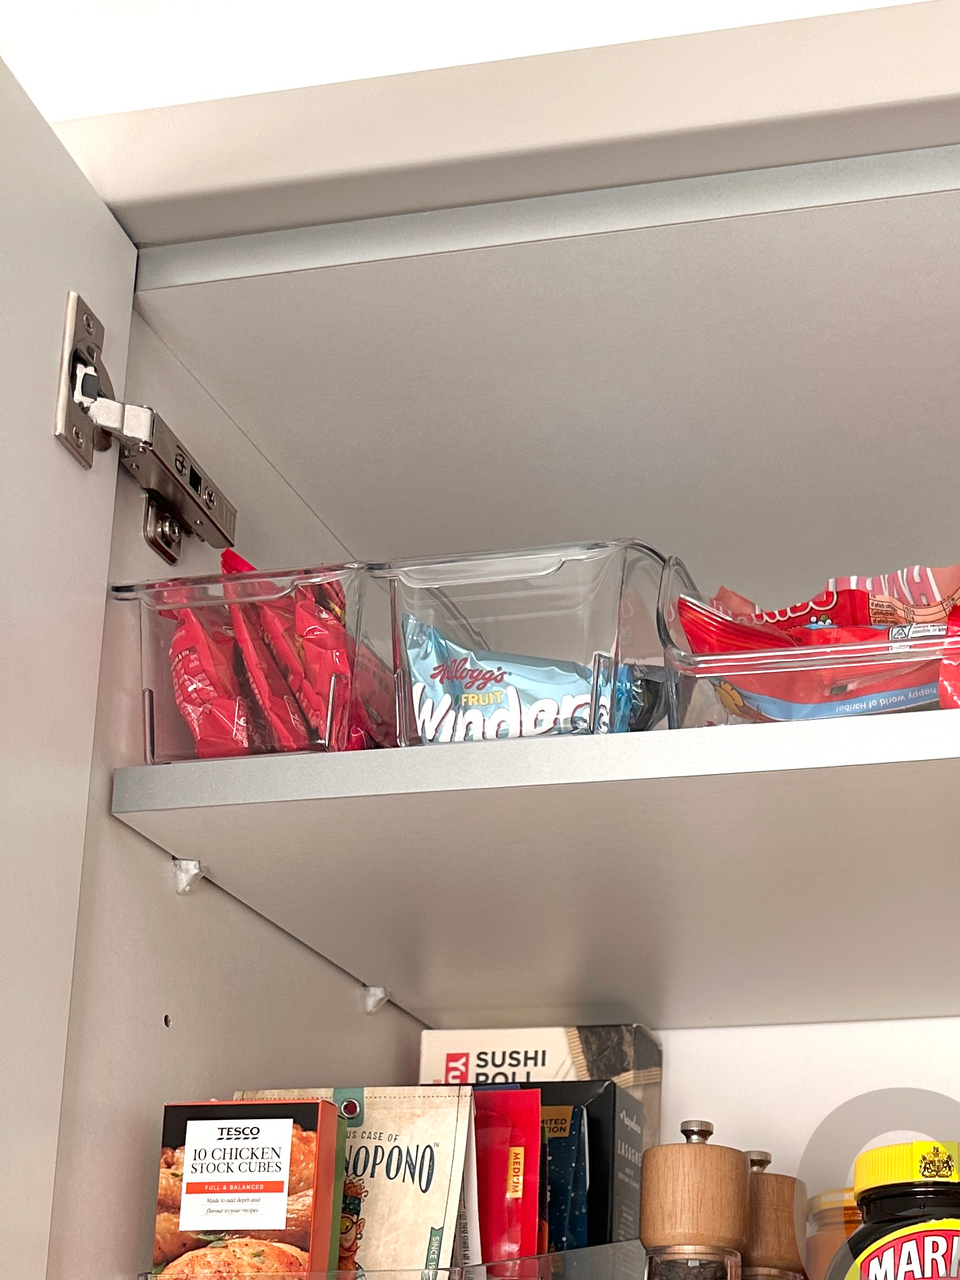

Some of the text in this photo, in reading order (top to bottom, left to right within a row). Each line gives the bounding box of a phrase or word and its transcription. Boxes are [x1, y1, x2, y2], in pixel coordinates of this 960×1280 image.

[430, 657, 508, 691] Kellogg's
[461, 690, 503, 707] FRUIT
[835, 687, 937, 713] happy world of Haribo!
[475, 1050, 546, 1068] SUSHI
[217, 1126, 261, 1137] TESCO
[361, 1130, 400, 1143] CASE OF
[192, 1147, 282, 1161] 10 CHICKEN
[190, 1161, 282, 1174] STOCK CUBES
[510, 1151, 522, 1194] MEDIUM
[229, 1183, 265, 1191] BALANCED
[429, 1236, 440, 1259] SINCE
